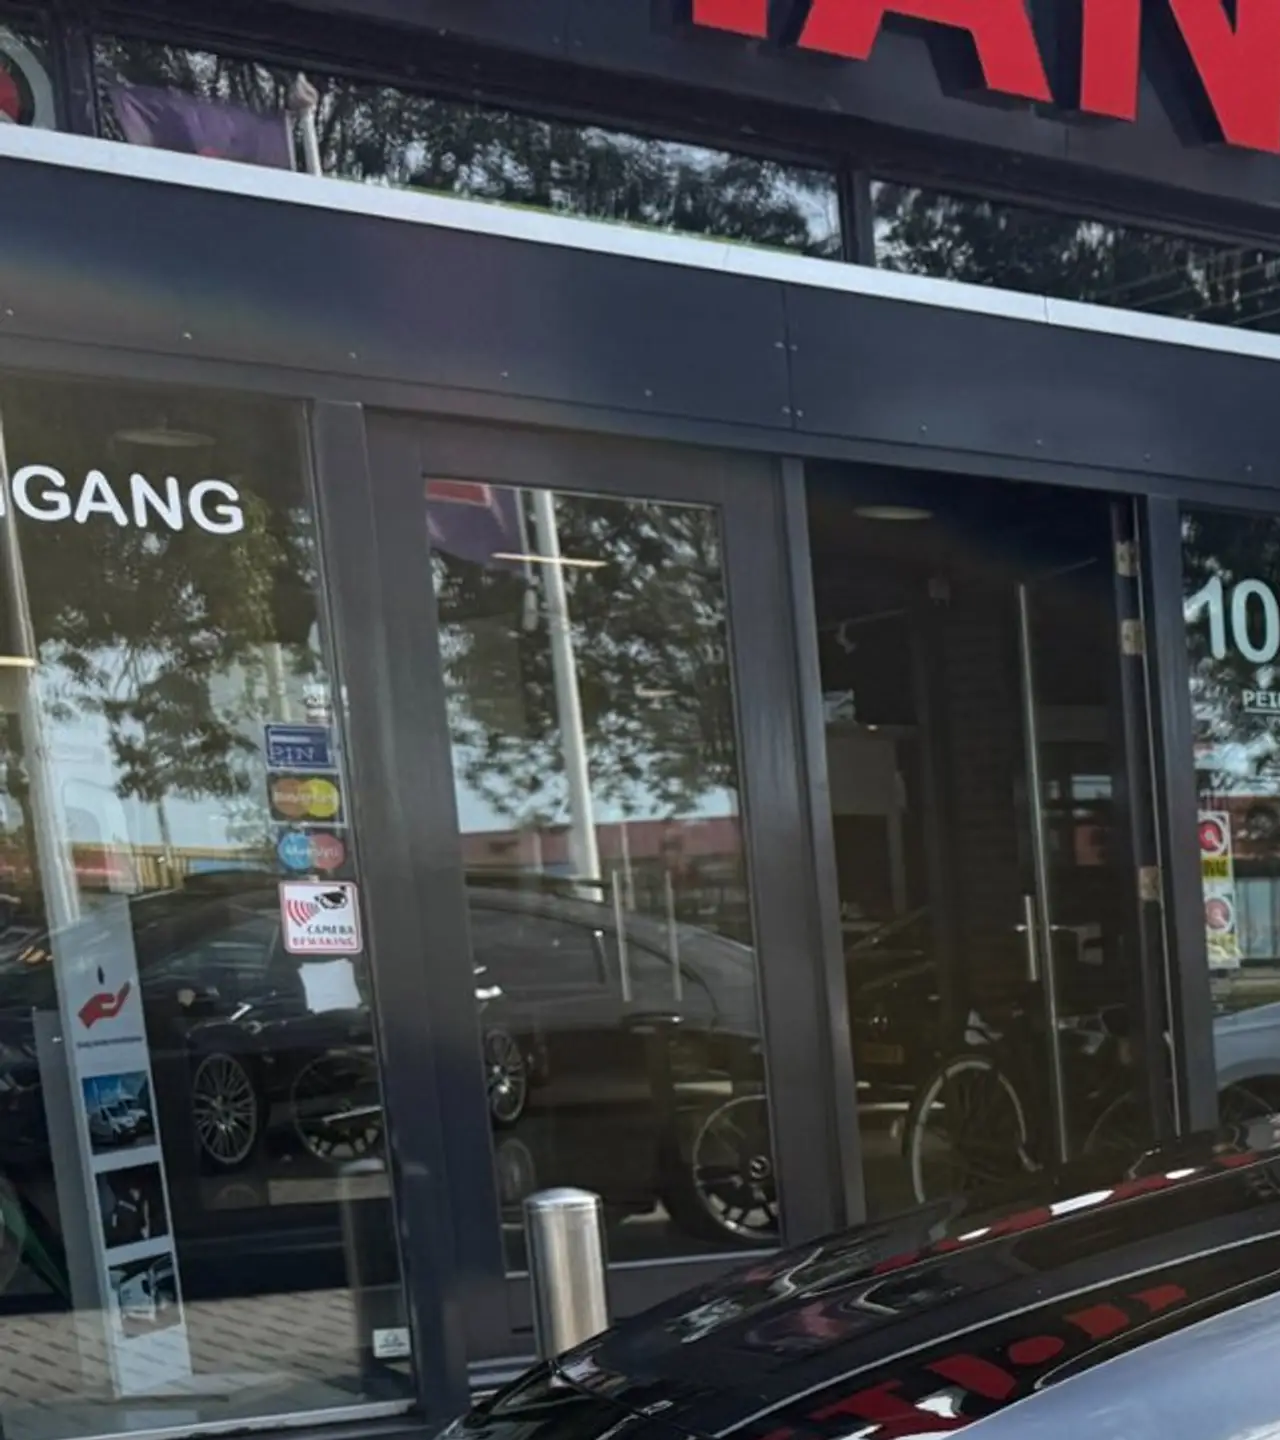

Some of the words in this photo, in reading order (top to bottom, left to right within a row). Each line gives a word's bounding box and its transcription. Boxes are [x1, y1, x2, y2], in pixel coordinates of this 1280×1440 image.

[0, 464, 244, 534] GANG
[270, 745, 314, 761] PIN
[307, 924, 354, 935] CAMERA
